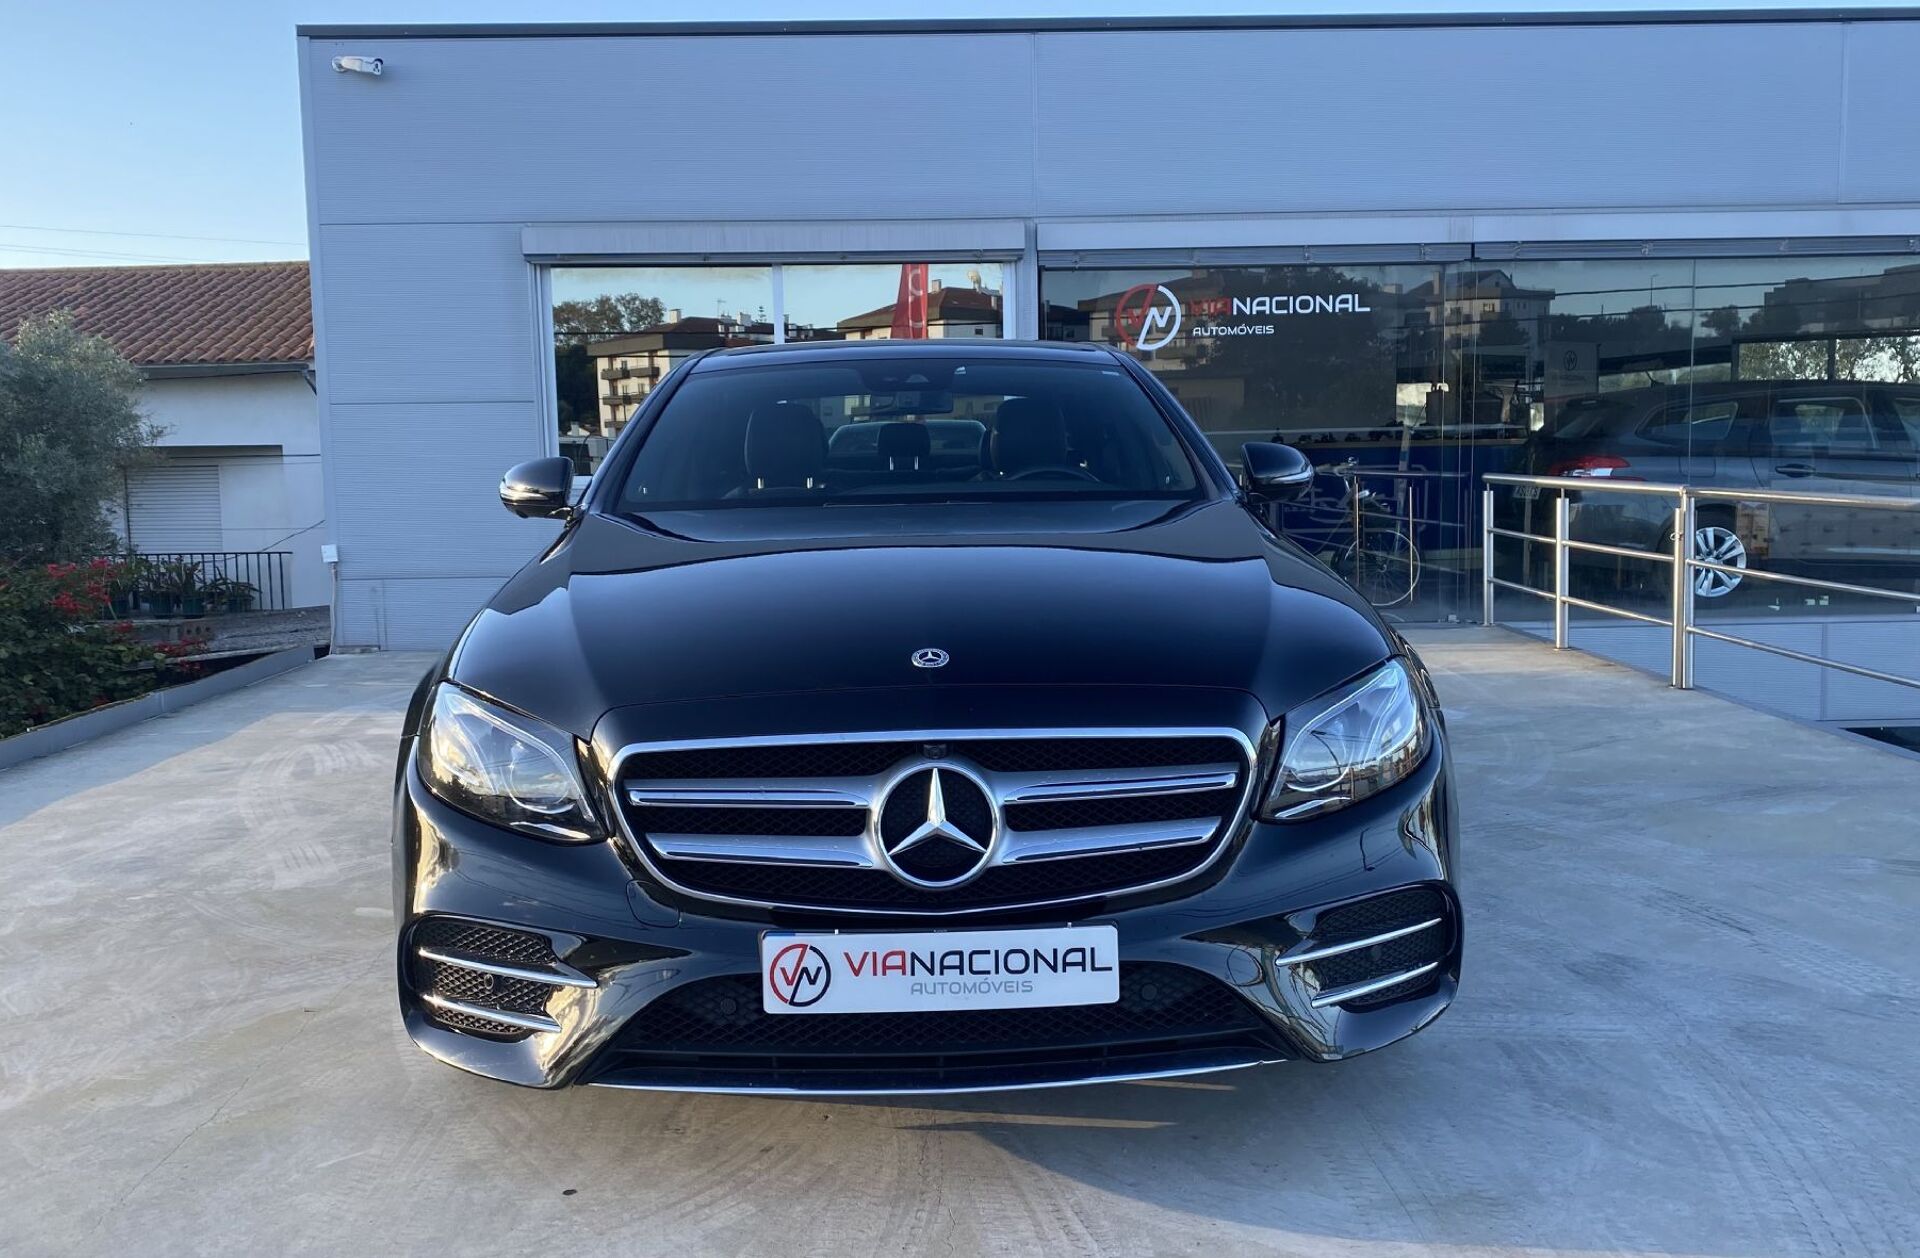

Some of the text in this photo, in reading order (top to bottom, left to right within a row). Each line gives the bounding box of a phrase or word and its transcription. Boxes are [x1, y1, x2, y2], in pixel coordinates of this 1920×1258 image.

[1193, 323, 1275, 337] AUTOMÓVEIS
[844, 946, 1113, 977] VIANACIONAL
[910, 977, 1034, 995] AUTOMÓVEIS
